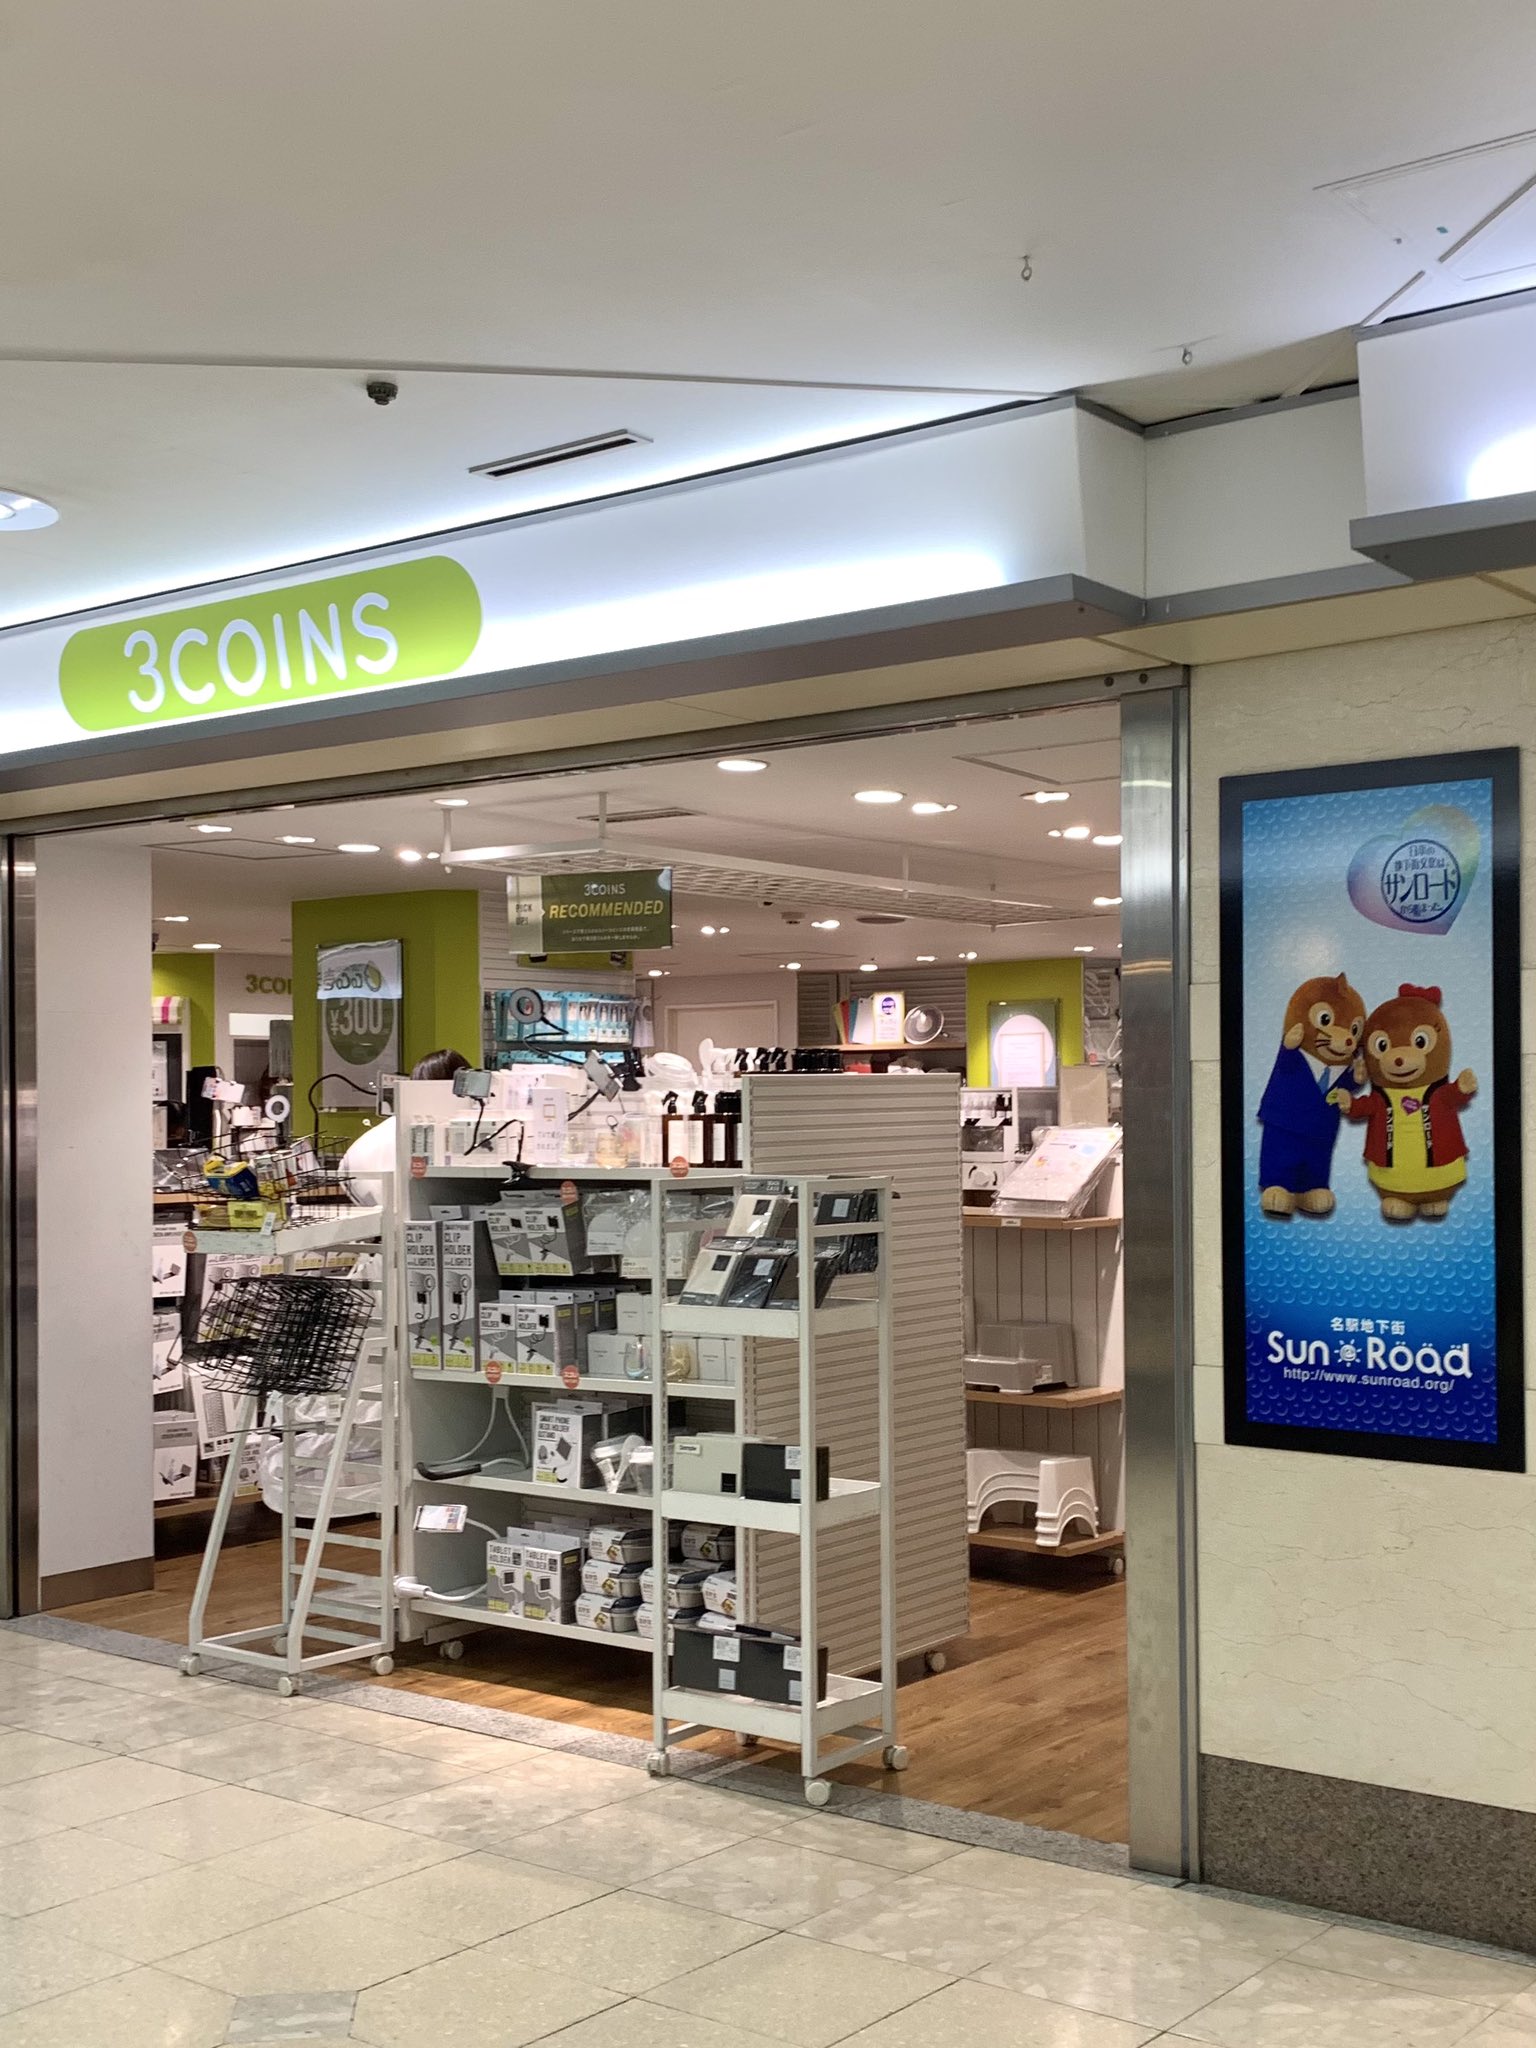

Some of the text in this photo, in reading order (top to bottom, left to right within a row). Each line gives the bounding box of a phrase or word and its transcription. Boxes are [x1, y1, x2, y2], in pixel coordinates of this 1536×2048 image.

[123, 592, 398, 713] 3COINS
[584, 883, 626, 897] 3COINS
[1385, 869, 1457, 905] サンロード
[549, 900, 664, 919] RECOMMENDED
[1267, 1330, 1330, 1366] Sun
[1283, 1366, 1455, 1394] http://www.sunroad.org/
